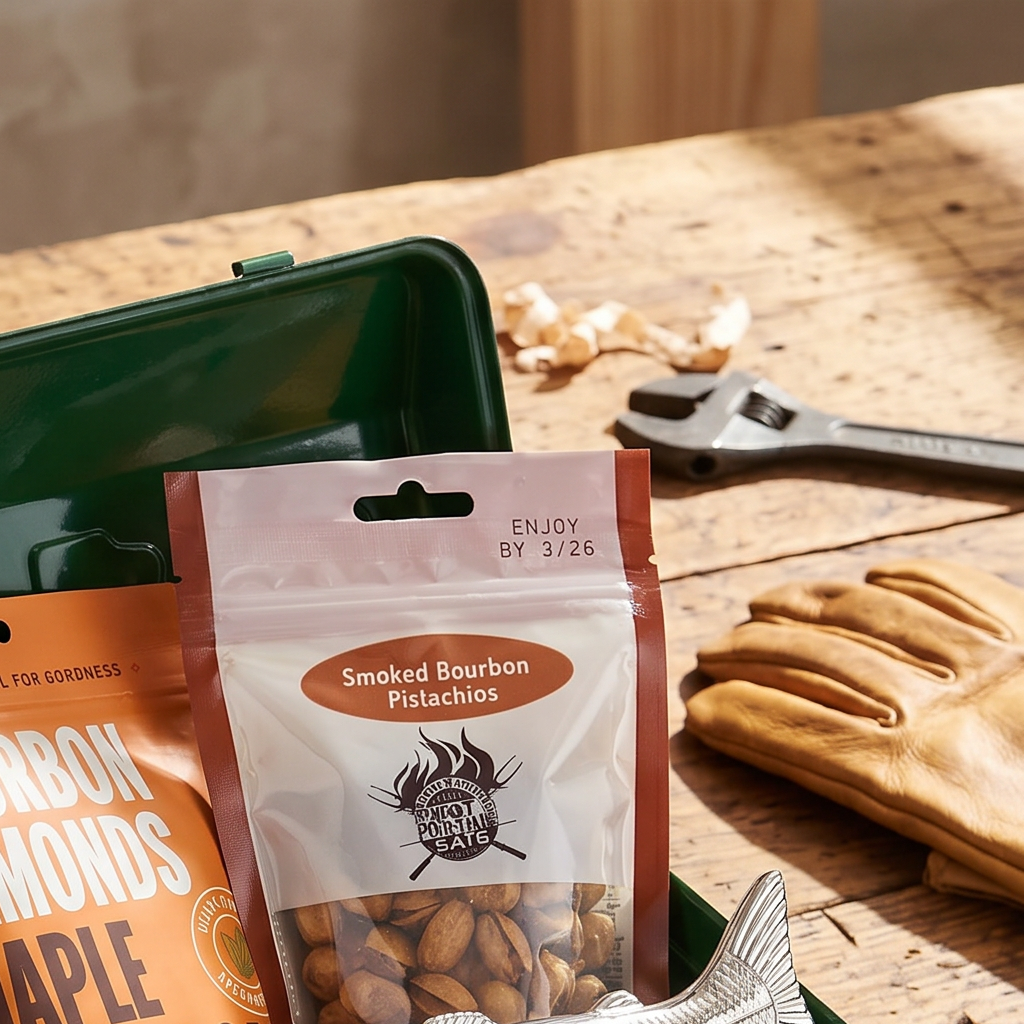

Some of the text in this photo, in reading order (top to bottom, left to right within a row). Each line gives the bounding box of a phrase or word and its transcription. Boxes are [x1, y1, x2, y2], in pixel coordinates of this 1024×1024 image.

[512, 518, 578, 535] ENJOY
[500, 540, 594, 558] BY 3/26
[11, 672, 41, 688] FOR
[342, 657, 529, 687] Smoked Bourbon
[388, 686, 498, 709] Pistachios
